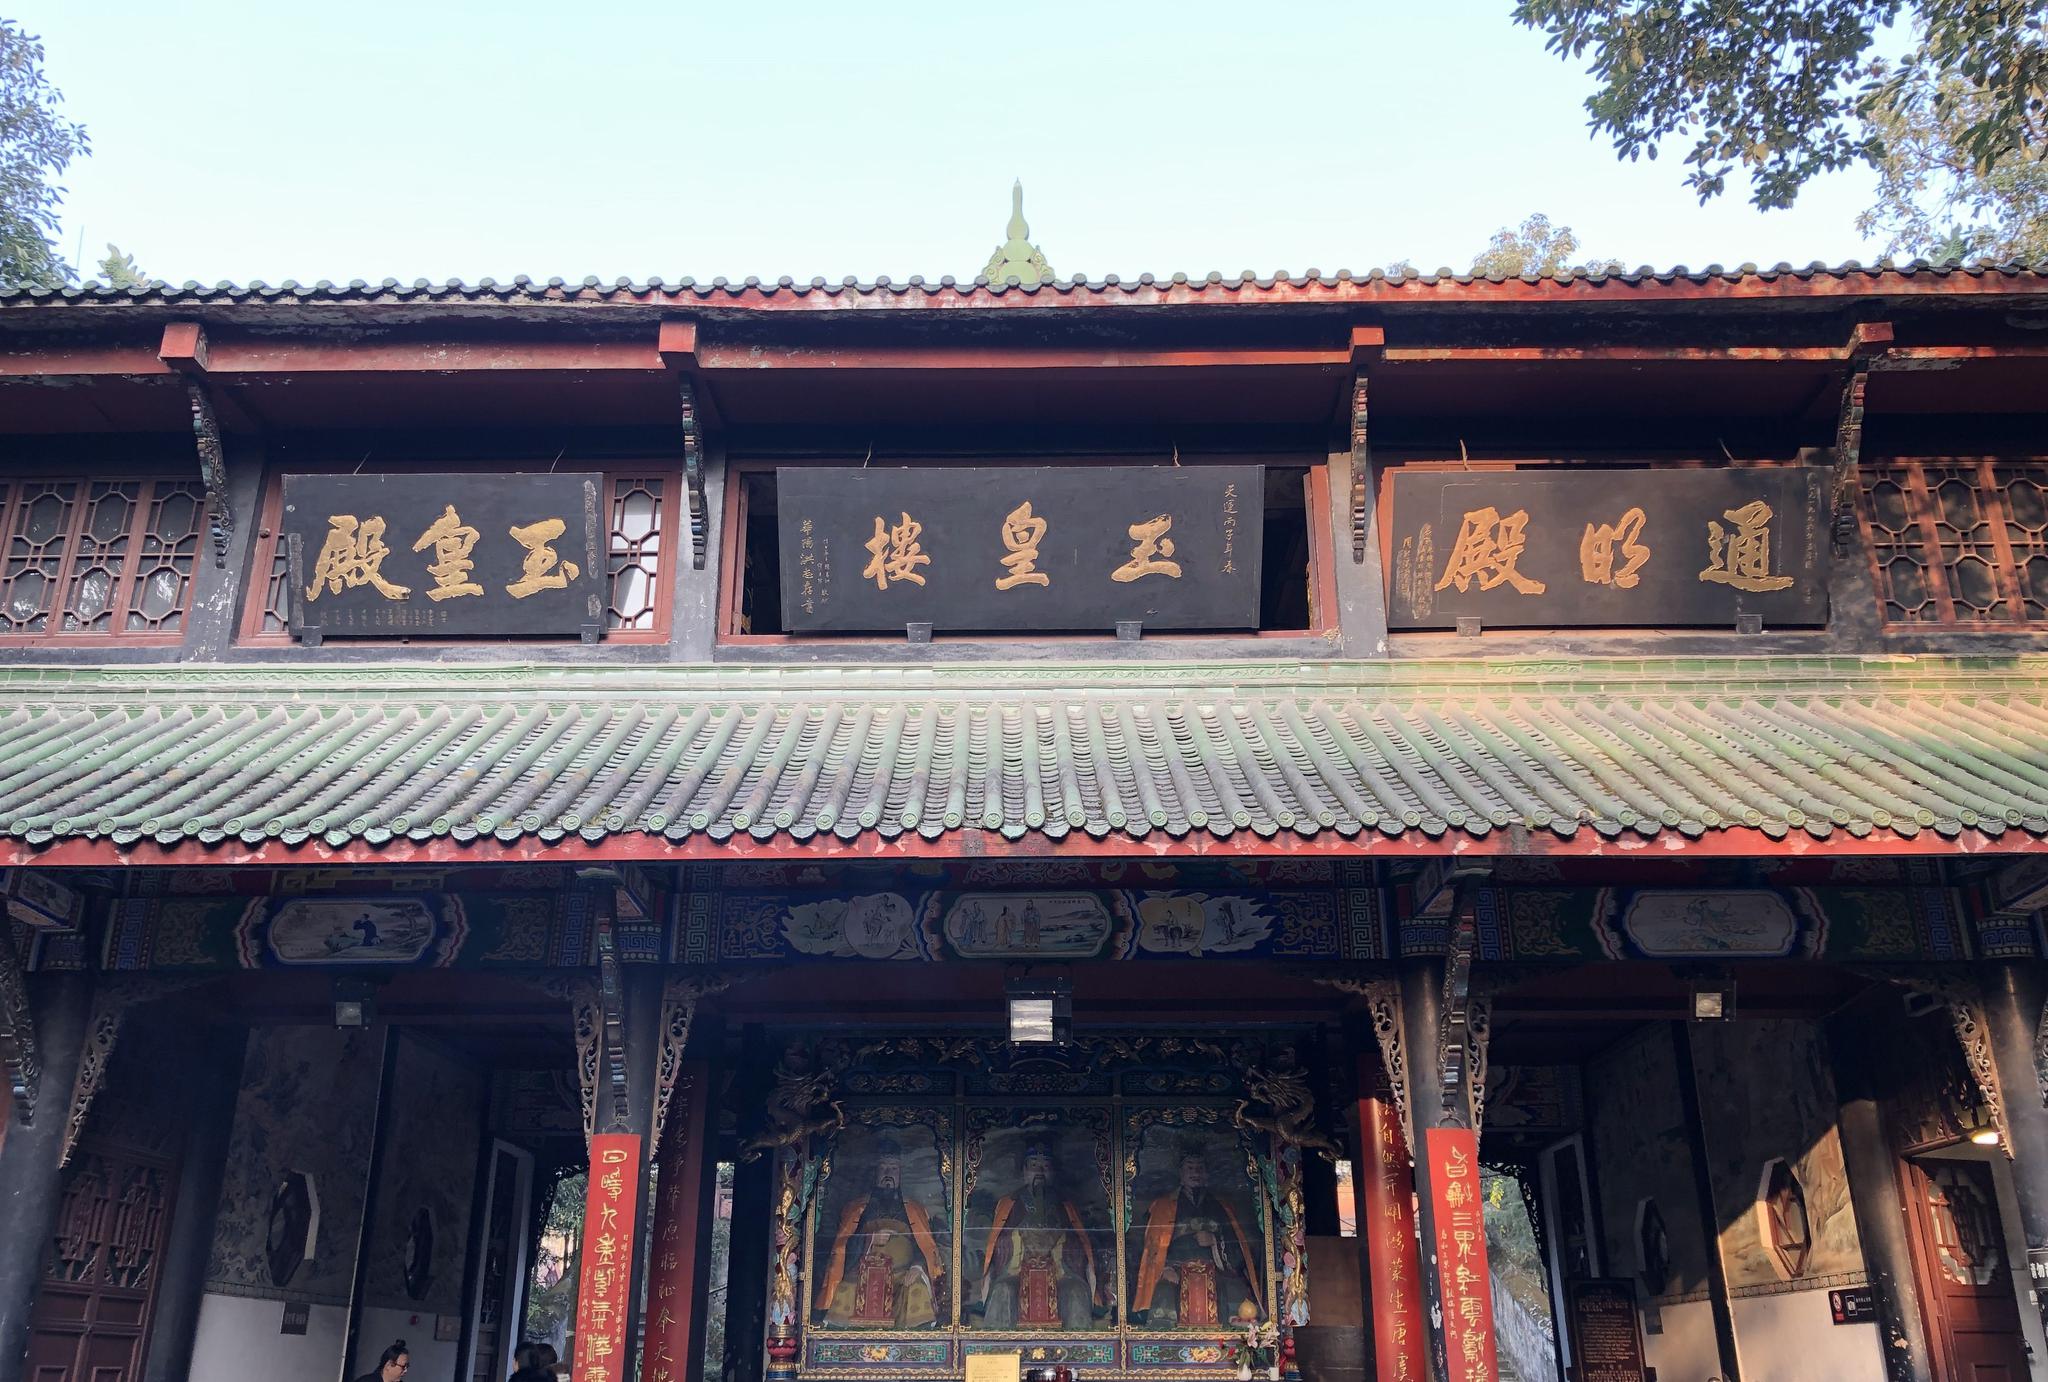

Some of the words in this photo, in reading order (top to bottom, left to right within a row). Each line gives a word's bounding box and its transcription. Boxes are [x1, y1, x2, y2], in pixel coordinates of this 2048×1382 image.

[306, 505, 580, 602] 玉皇殿
[862, 500, 1183, 591] 玉皇樓
[1434, 500, 1795, 595] 通明殿
